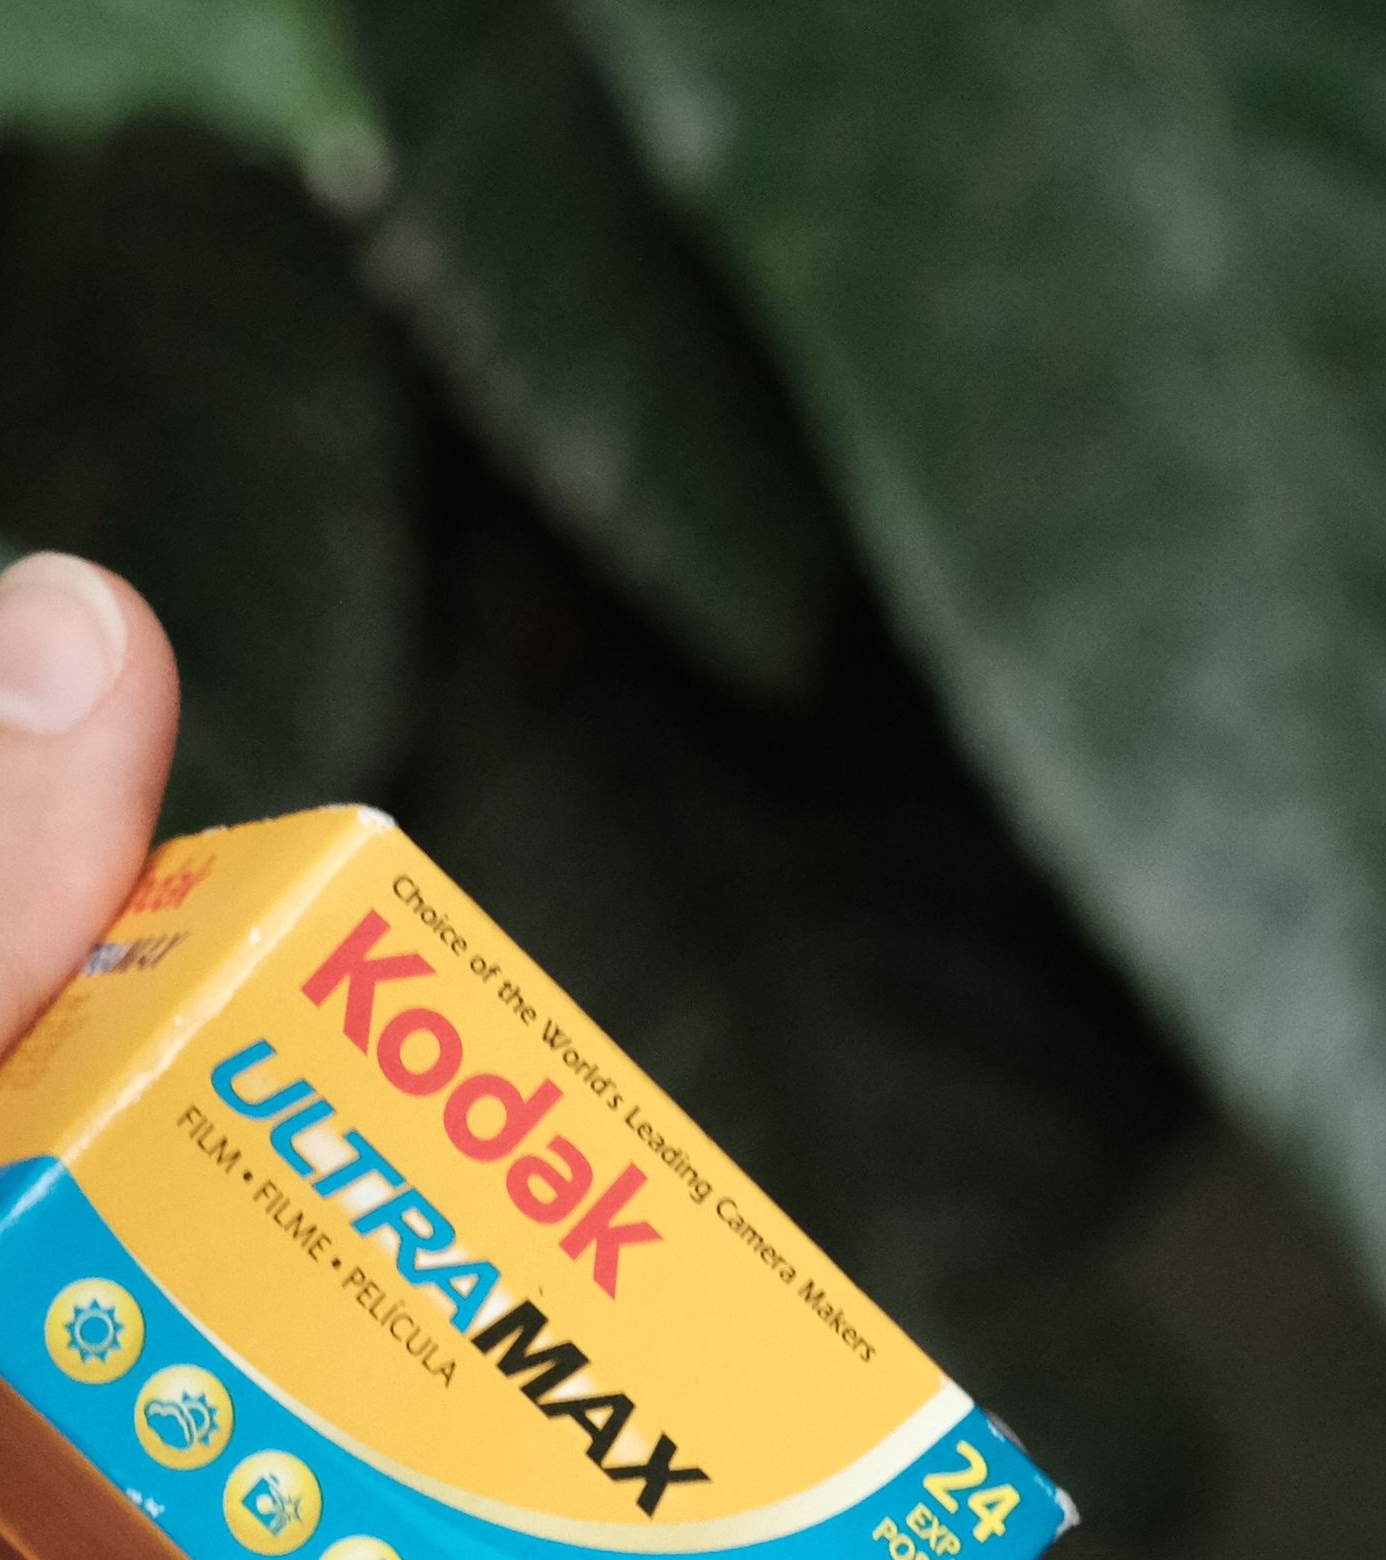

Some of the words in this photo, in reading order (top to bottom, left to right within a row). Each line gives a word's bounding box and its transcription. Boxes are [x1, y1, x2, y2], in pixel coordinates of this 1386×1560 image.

[177, 1104, 243, 1175] FILM
[252, 1180, 330, 1265] FILME
[341, 1266, 457, 1389] PELÍCULA
[210, 1038, 713, 1519] ULTRAMAX
[301, 908, 664, 1300] Kodak
[391, 872, 469, 956] Choice
[468, 949, 503, 985] of
[495, 975, 538, 1026] the
[541, 1017, 624, 1111] World's
[622, 1104, 715, 1205] Leading
[715, 1197, 797, 1284] Camera
[797, 1278, 877, 1364] Makers
[922, 1441, 1021, 1544] 24
